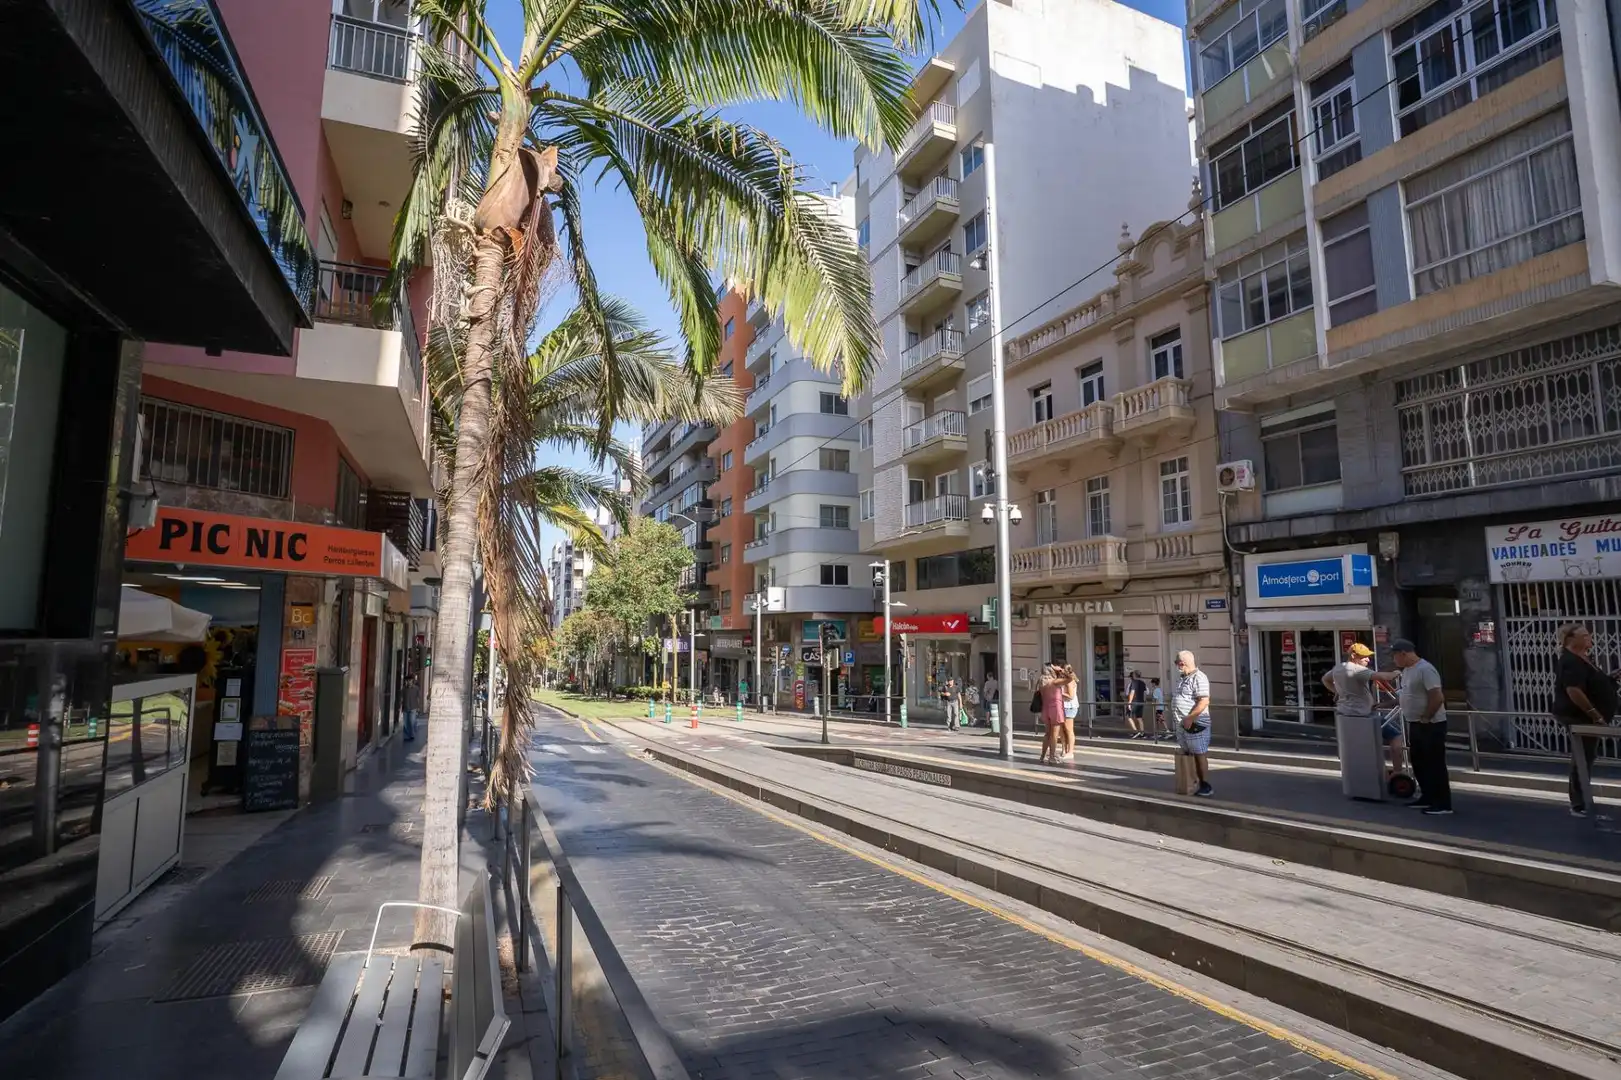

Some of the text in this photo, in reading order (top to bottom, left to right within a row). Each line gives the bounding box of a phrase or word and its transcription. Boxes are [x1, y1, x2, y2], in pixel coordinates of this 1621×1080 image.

[159, 518, 308, 561] PIC NIC
[1504, 526, 1542, 541] La
[1491, 541, 1577, 560] VARIEDADES
[1036, 601, 1114, 615] FARMACIA
[845, 653, 853, 662] P
